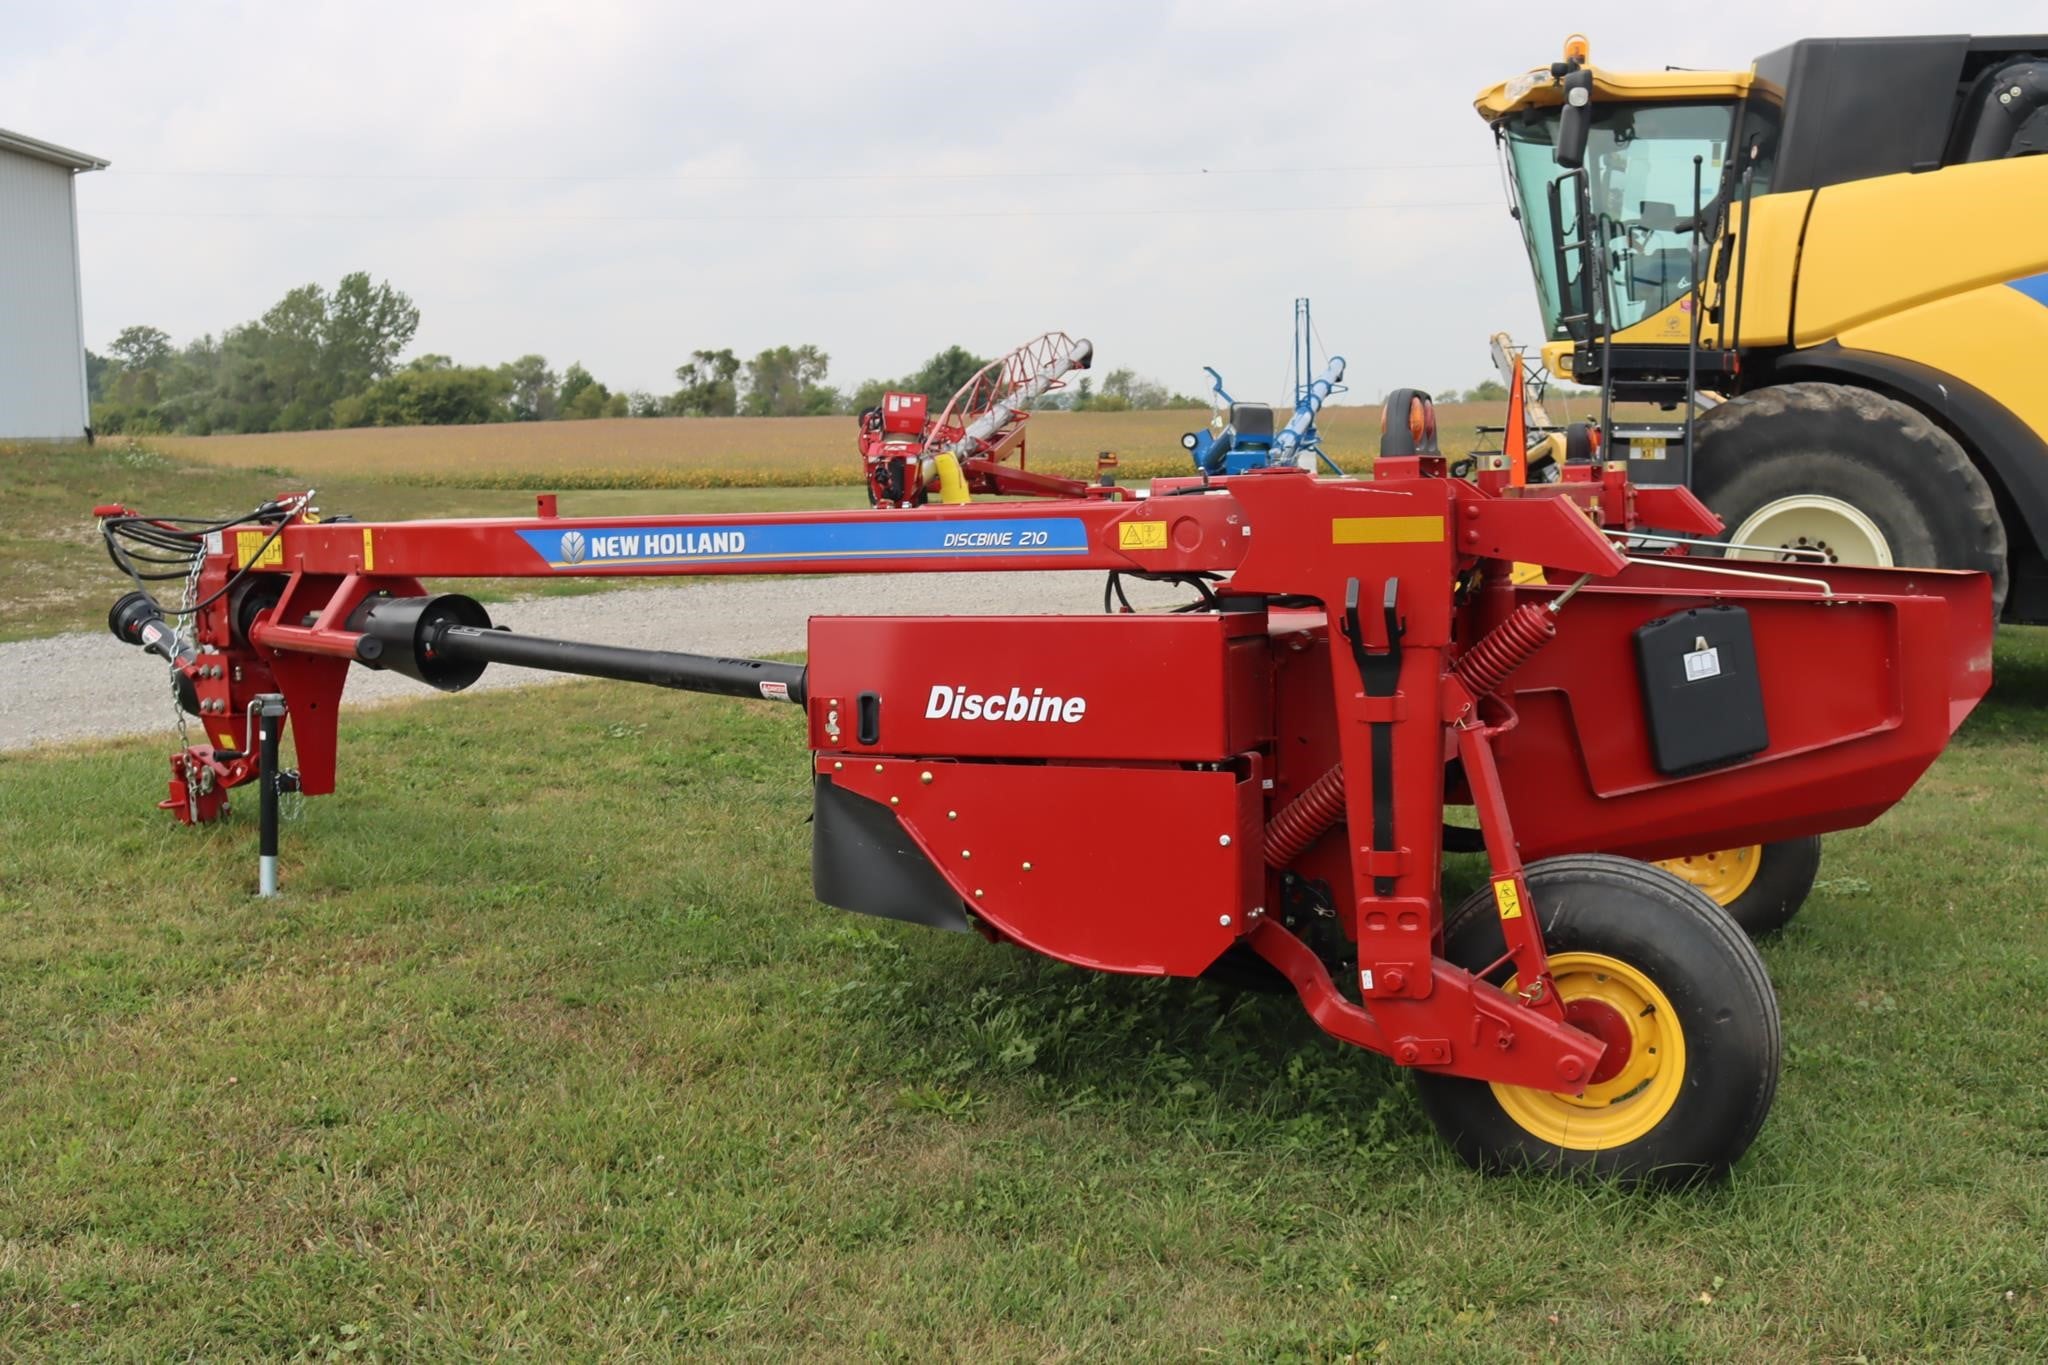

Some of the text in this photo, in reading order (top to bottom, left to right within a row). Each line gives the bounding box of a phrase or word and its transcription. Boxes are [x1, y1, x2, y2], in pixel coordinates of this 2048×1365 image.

[592, 532, 745, 557] NEW HOLLAND
[944, 532, 1048, 547] DISCBINE 210
[925, 685, 1086, 723] Discbine
